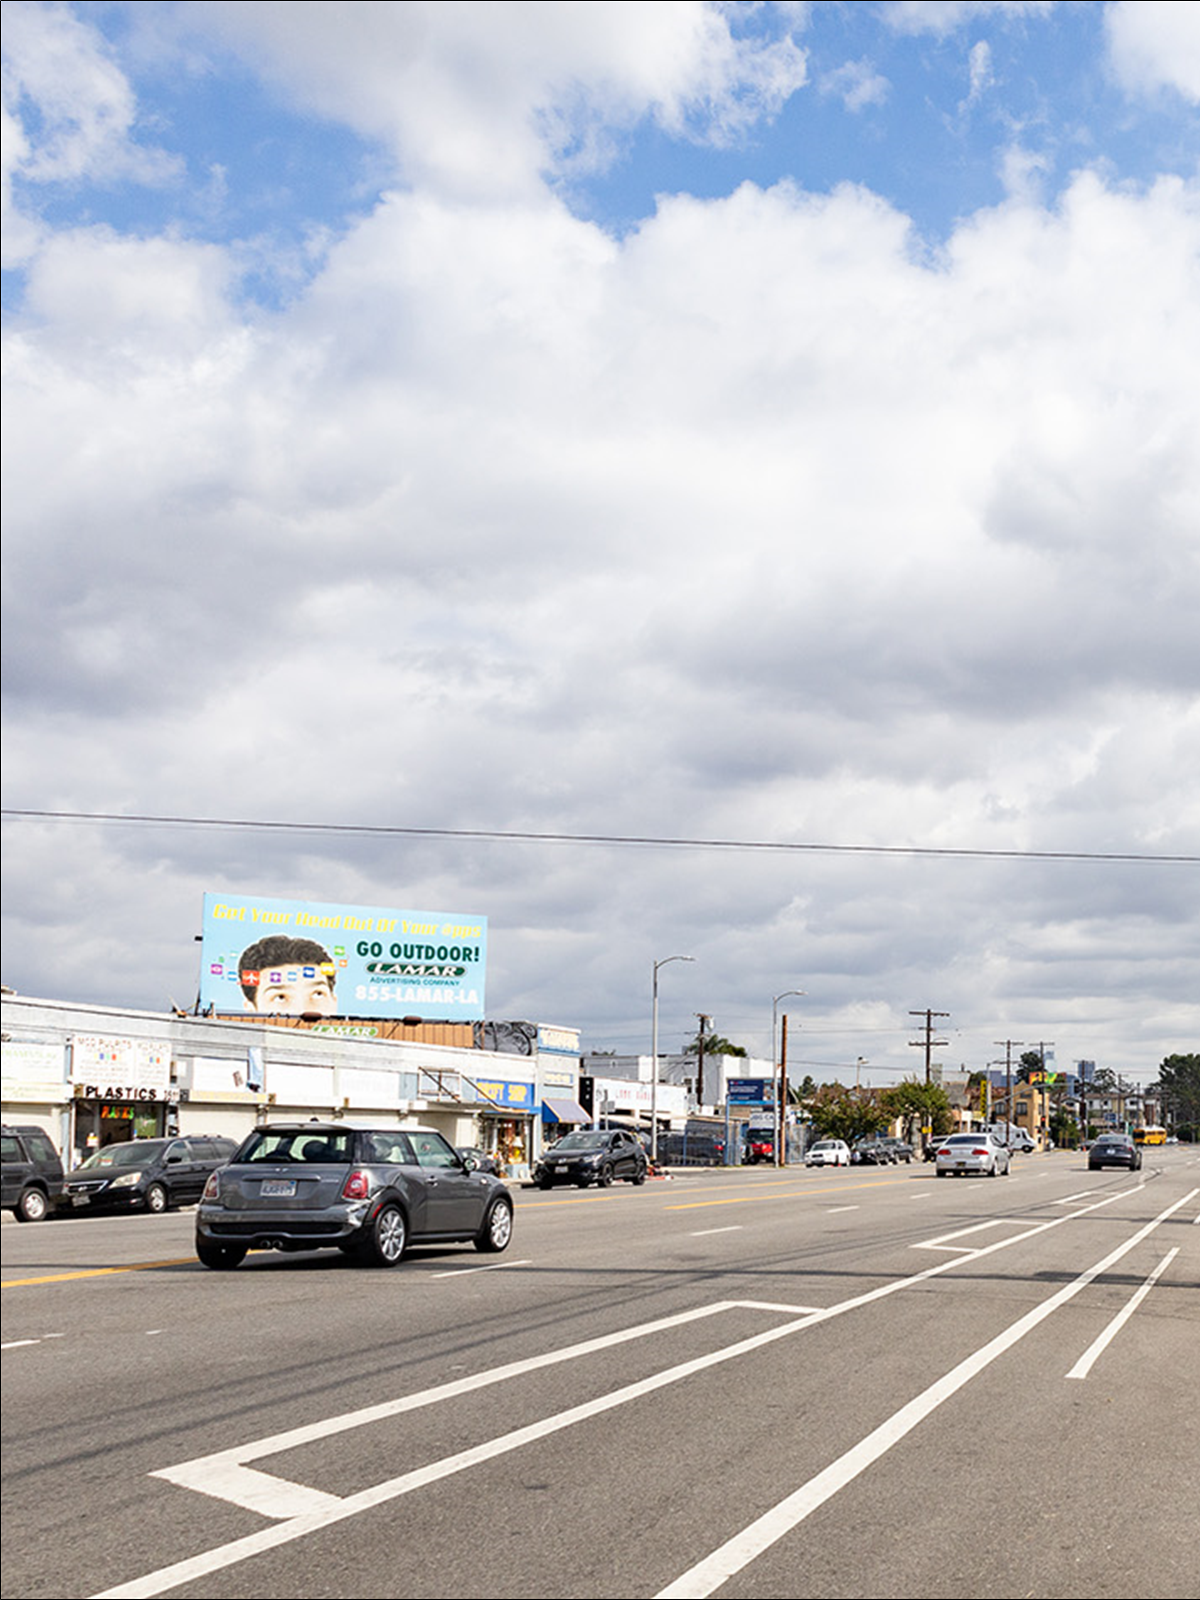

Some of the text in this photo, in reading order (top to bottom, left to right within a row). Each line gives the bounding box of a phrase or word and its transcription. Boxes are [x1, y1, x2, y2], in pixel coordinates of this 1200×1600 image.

[212, 904, 246, 921] Get
[252, 908, 293, 925] Your
[295, 912, 341, 928] Head
[343, 916, 373, 931] Out
[402, 920, 438, 935] Your
[356, 941, 479, 962] GO OUTDOOR!
[373, 963, 457, 976] LAMAR
[370, 977, 421, 985] ADVERTISING
[355, 985, 479, 1004] 855-LAMAR-LA
[317, 1026, 370, 1037] LAMAR
[86, 1086, 157, 1100] PLASTICS
